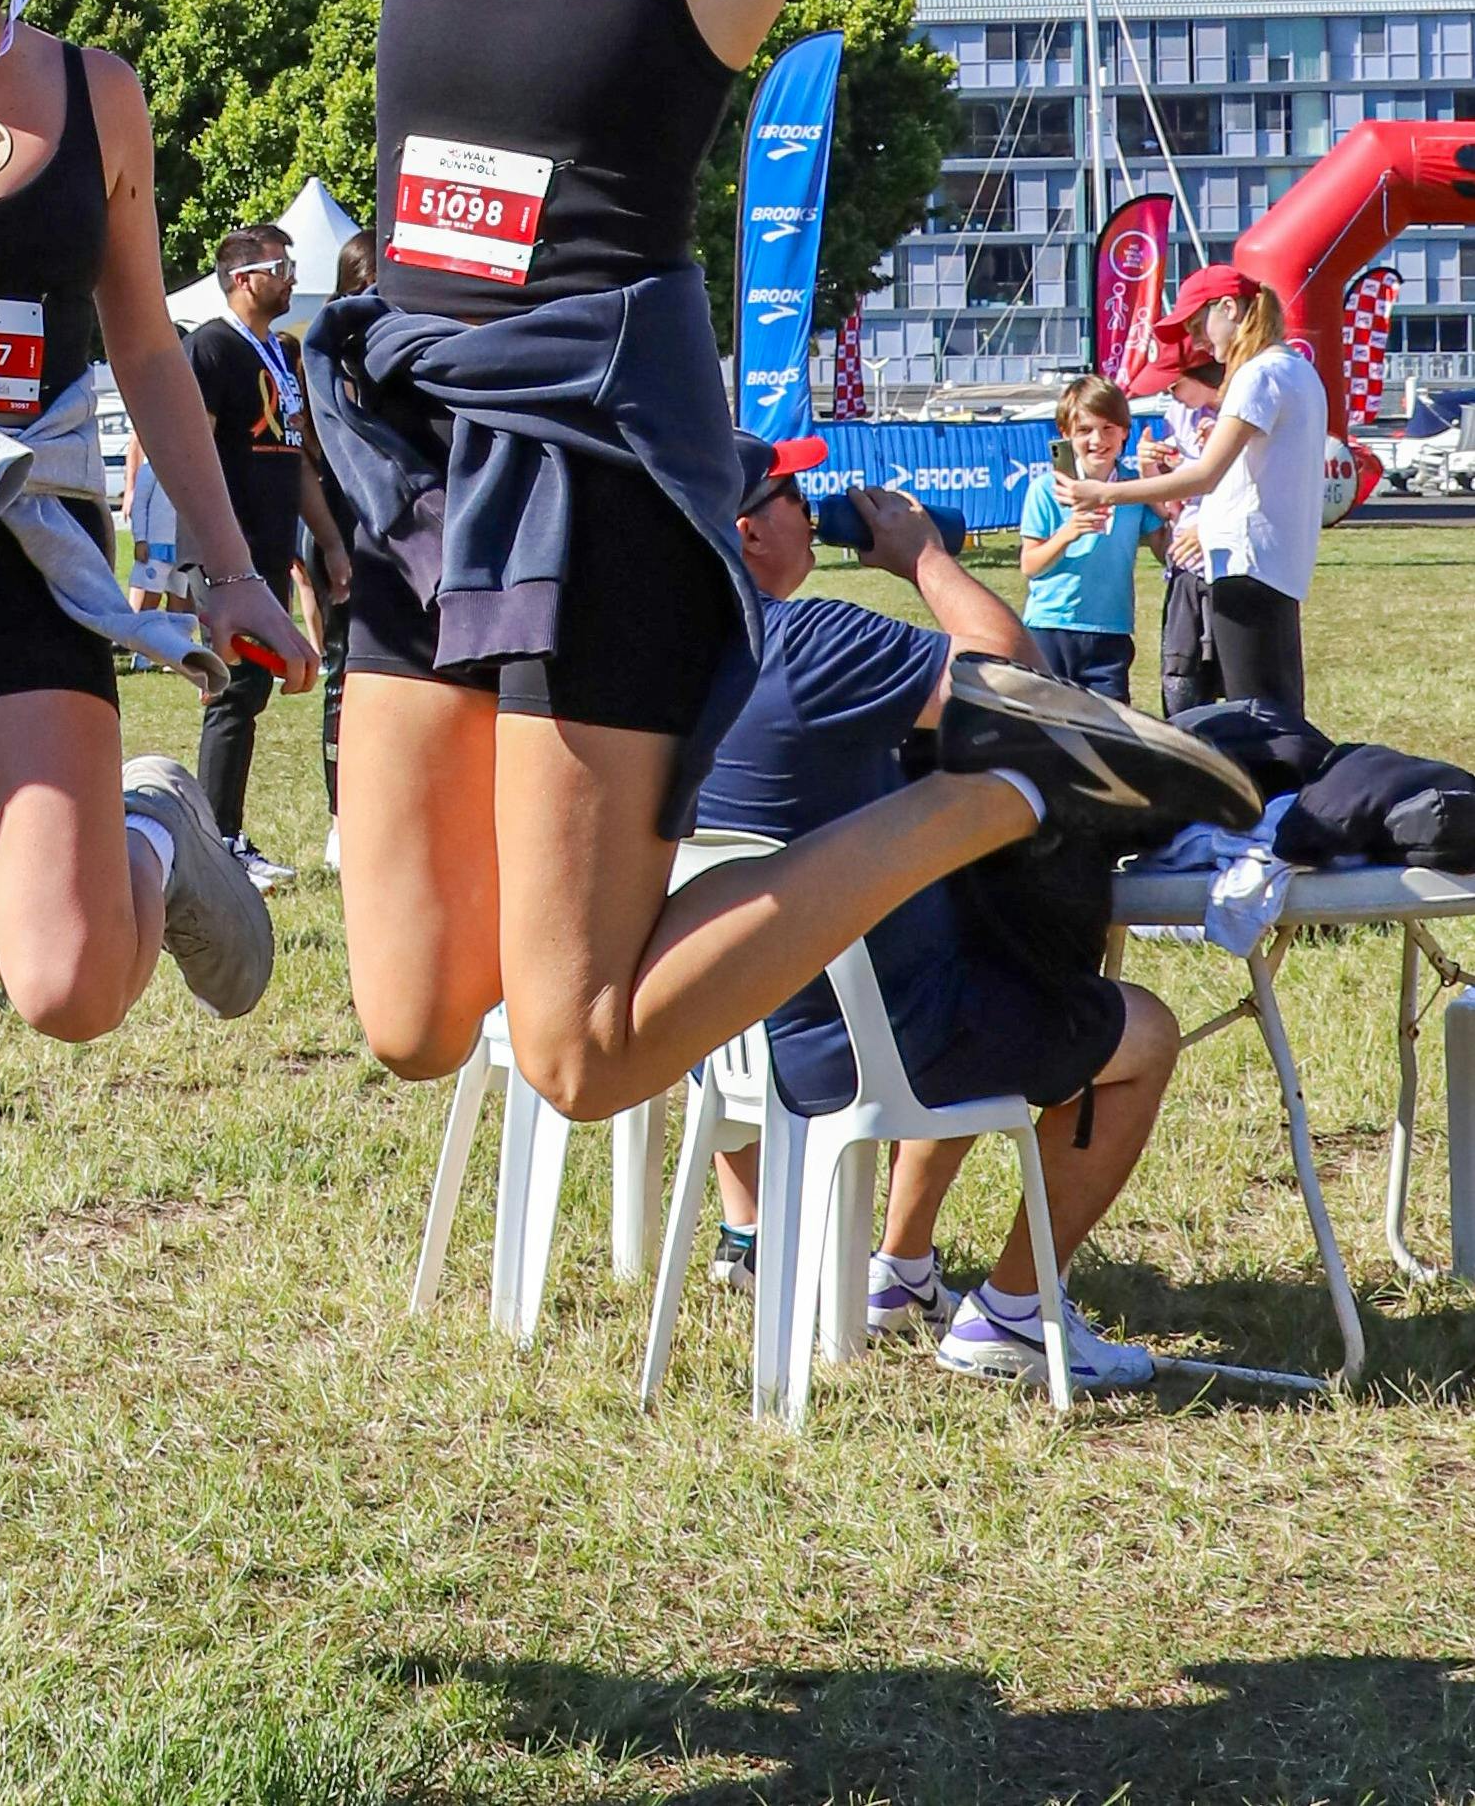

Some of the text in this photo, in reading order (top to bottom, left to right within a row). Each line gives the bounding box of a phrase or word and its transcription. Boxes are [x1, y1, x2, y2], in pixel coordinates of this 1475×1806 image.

[757, 124, 822, 140] BROOKS
[463, 151, 496, 164] WALK
[419, 188, 504, 226] 51098
[751, 206, 817, 222] BROOKS
[748, 289, 805, 304] BROOK
[914, 466, 990, 491] BROOKS
